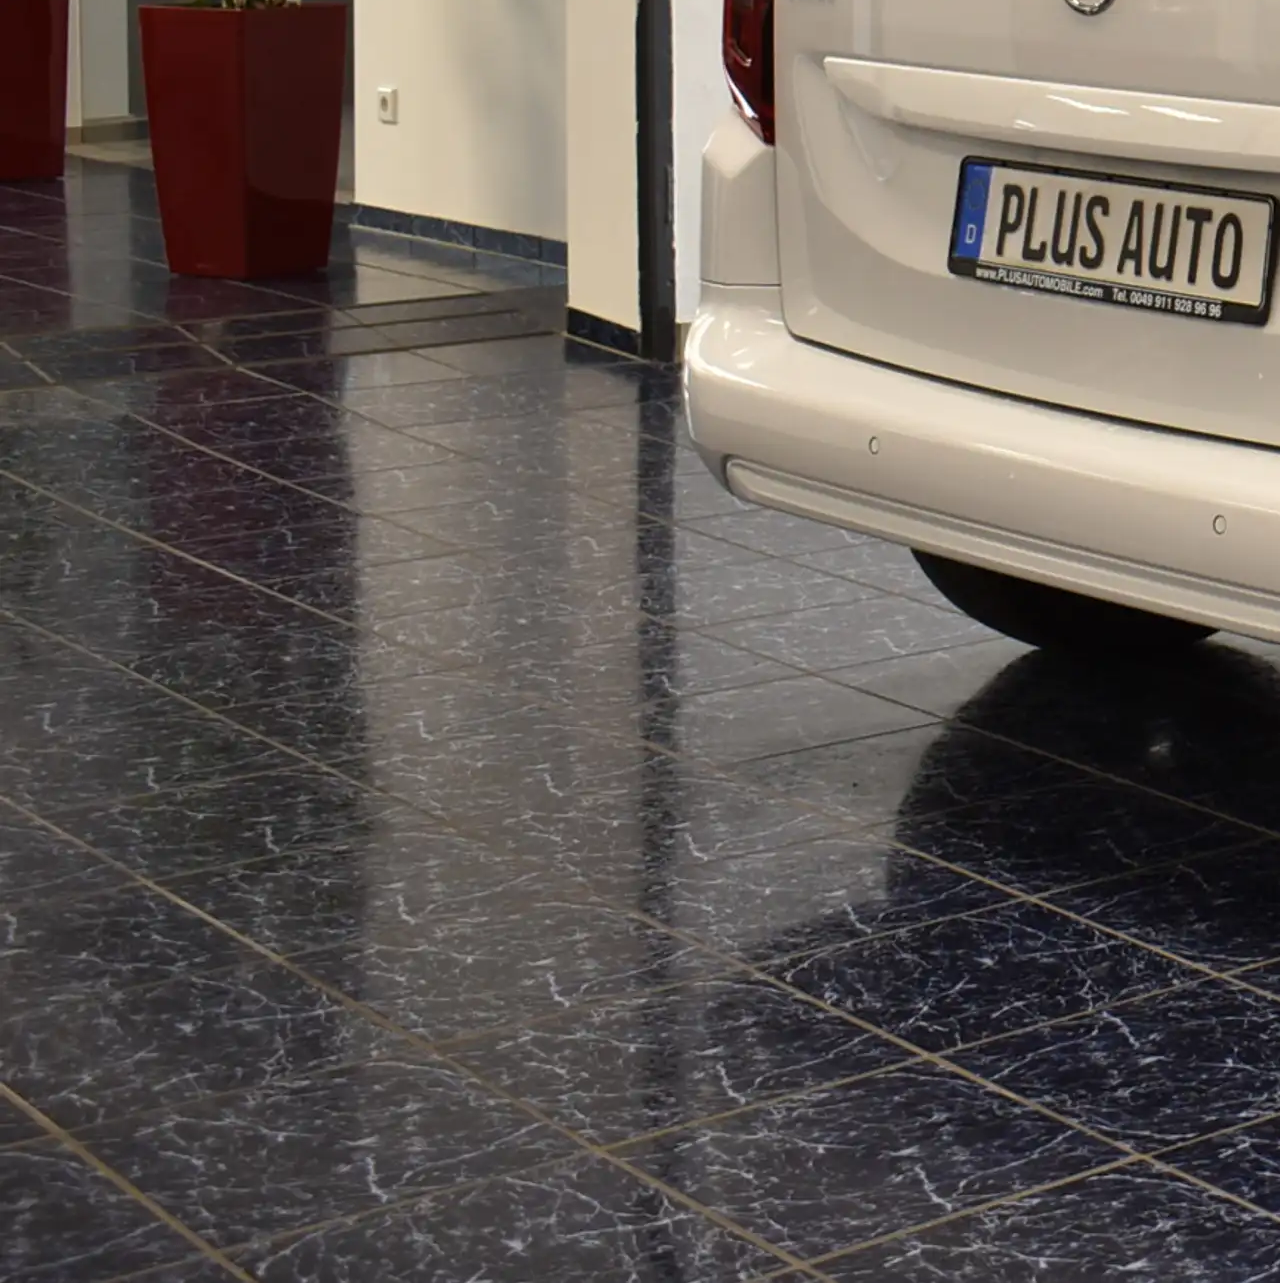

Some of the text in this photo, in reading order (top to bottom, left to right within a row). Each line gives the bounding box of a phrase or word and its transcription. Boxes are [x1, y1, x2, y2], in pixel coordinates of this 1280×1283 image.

[965, 223, 977, 244] D
[996, 183, 1244, 290] PLUS AUTO
[975, 266, 1221, 318] www.PLUSAUTOMOBILE.com Tel. 0049 911 928 96 96
